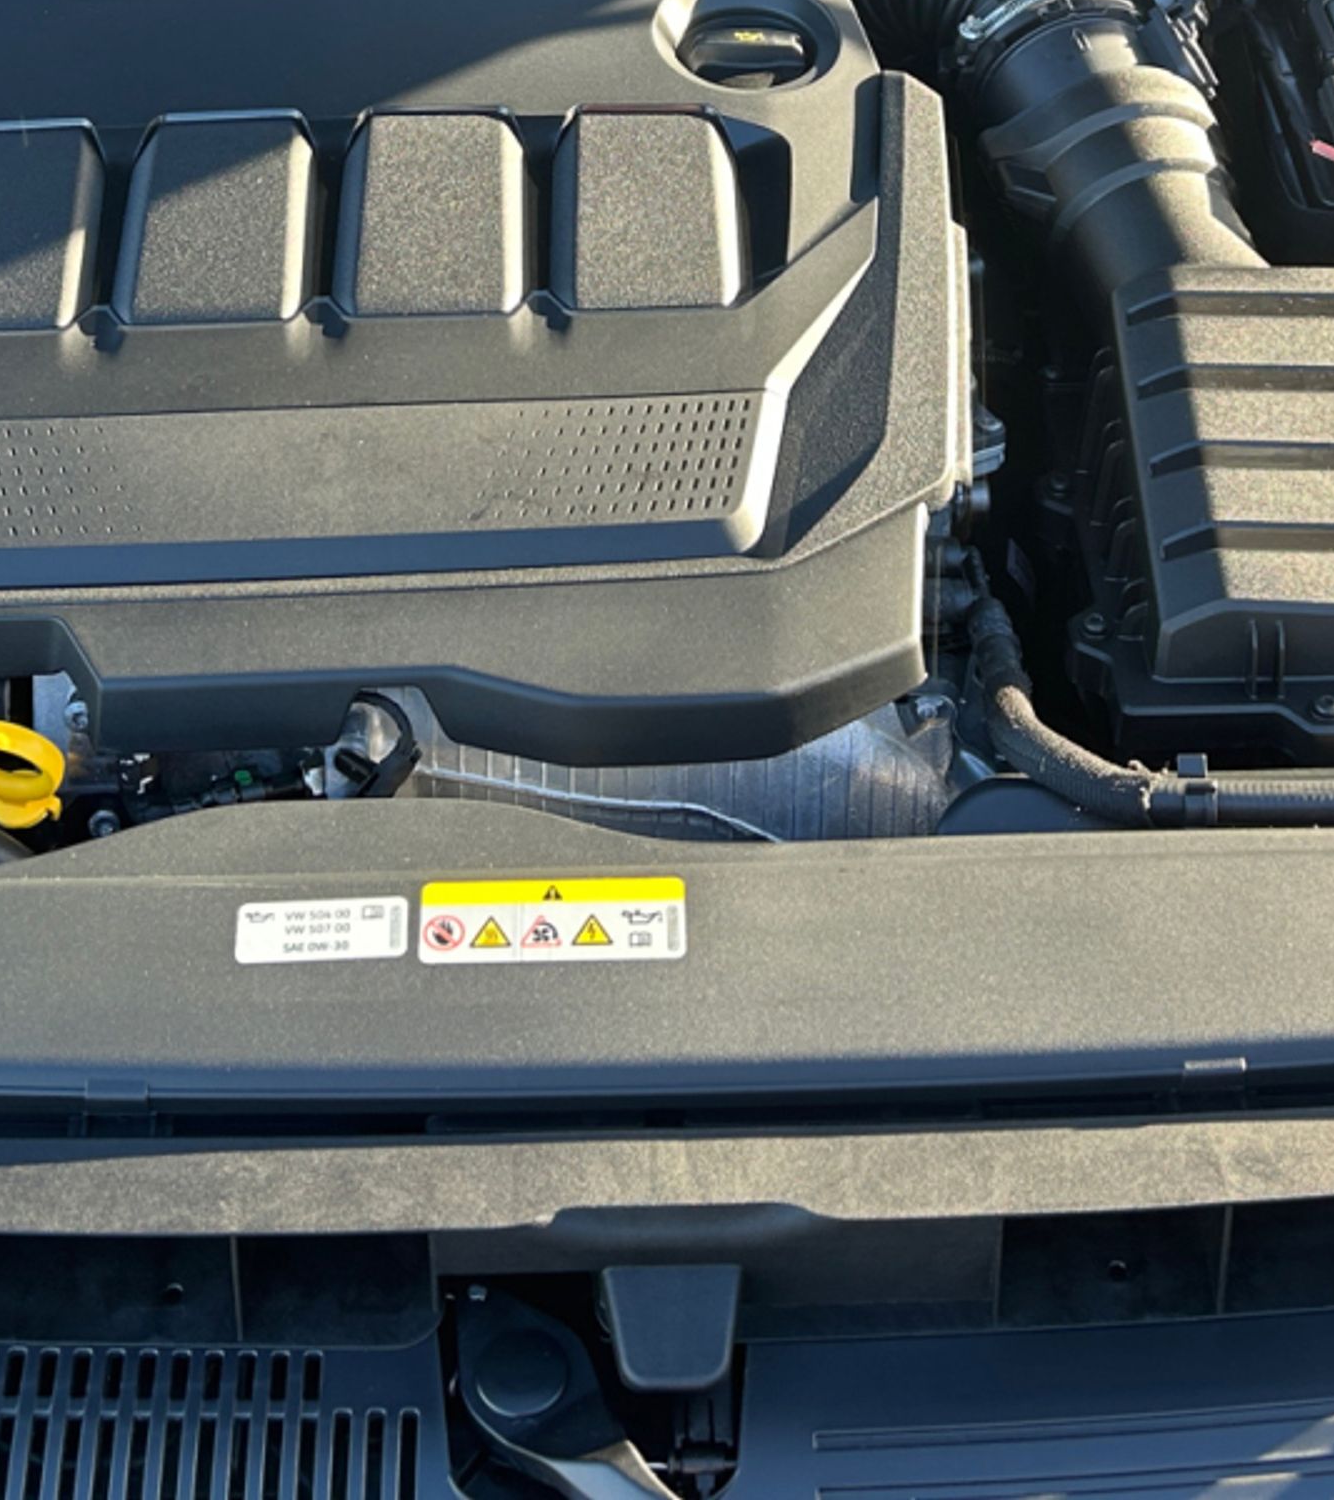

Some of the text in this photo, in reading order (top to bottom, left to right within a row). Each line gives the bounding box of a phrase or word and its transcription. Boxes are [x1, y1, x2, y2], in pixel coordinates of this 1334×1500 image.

[284, 908, 351, 921] VW 504 00
[284, 922, 351, 935] VW 507 00
[282, 939, 350, 953] SAE 0W-30
